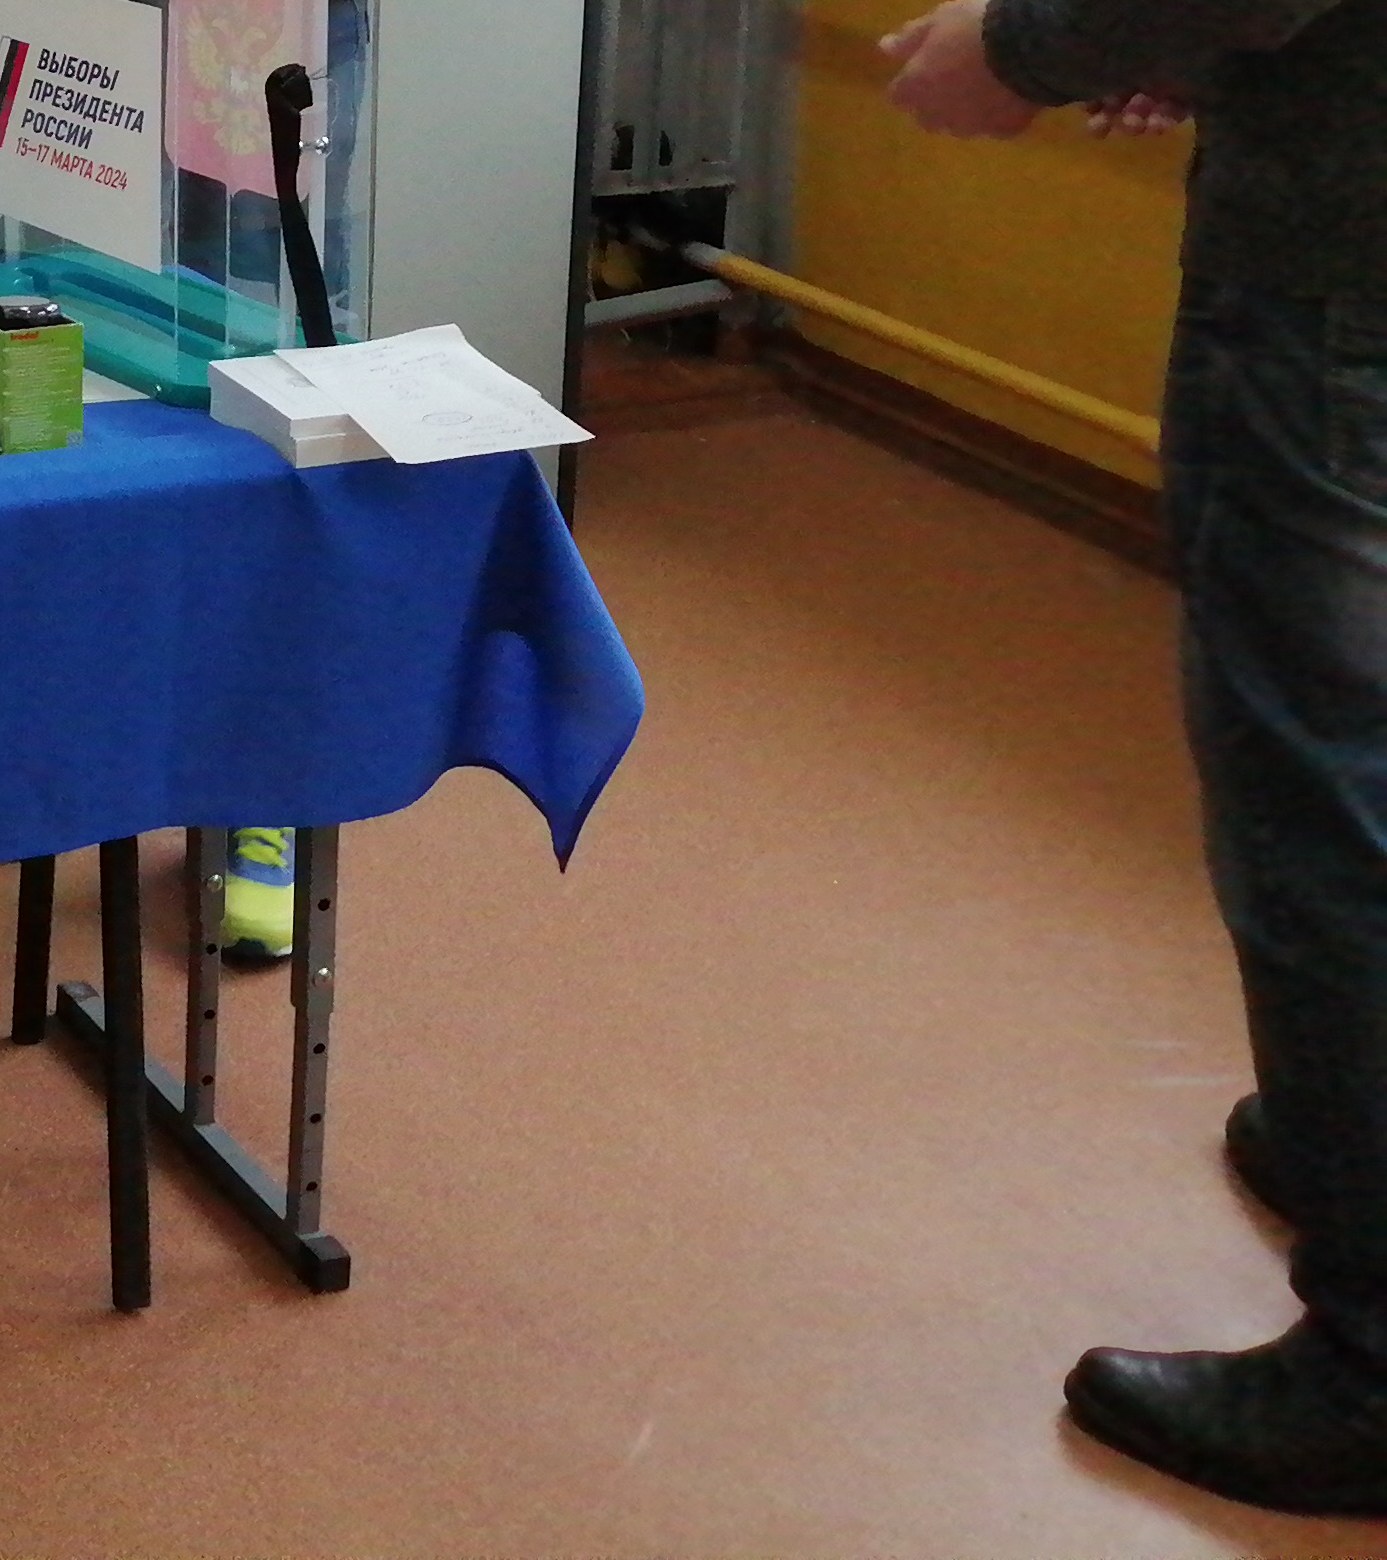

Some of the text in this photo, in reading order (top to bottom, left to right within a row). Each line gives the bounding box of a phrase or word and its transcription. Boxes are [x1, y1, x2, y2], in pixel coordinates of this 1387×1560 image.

[37, 48, 120, 91] ВЫБОРЫ
[29, 78, 145, 133] ПРЕЗИДЕНТА
[21, 107, 93, 149] РОССИИ
[51, 148, 94, 179] МАРТА
[95, 164, 128, 190] 2024
